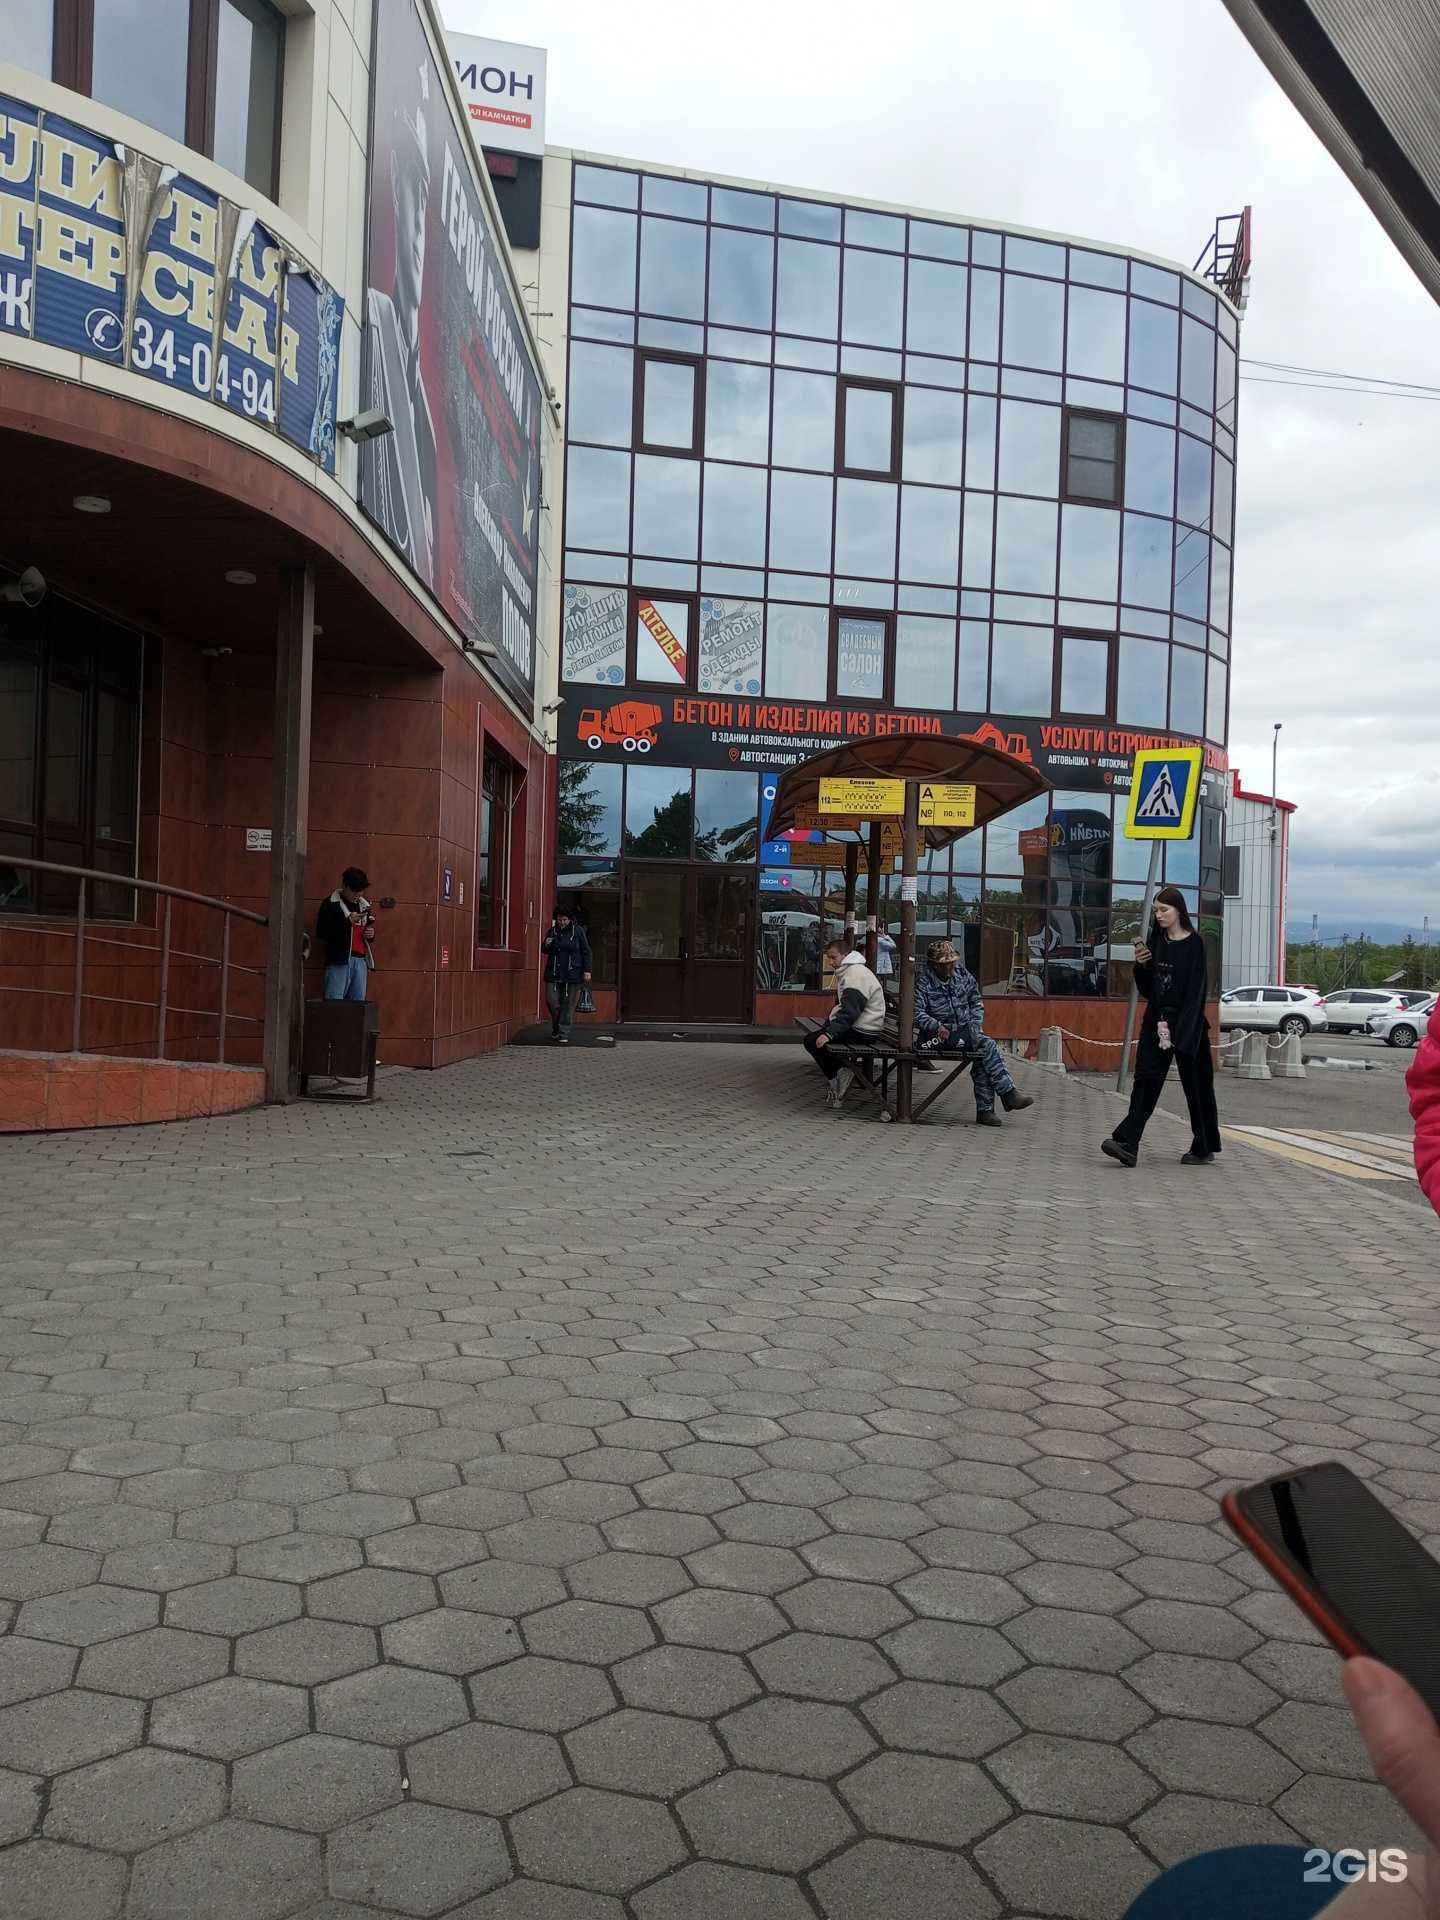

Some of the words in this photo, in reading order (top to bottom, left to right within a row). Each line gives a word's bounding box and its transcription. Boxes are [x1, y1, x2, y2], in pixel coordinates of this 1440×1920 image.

[482, 109, 528, 126] КАМЧАТКИ
[441, 140, 486, 316] ГЕРОЙ
[484, 266, 524, 426] РОССИИ
[131, 317, 277, 422] 34-04-94
[565, 590, 626, 632] ПОДШИВ
[502, 584, 531, 681] ПОПОВ
[565, 615, 625, 656] ПОДГОНКА
[639, 606, 685, 663] АТЕЛЬЕ
[701, 611, 762, 653] РЕМОНТ
[841, 632, 882, 651] СВАДЕБНЫЙ
[700, 637, 761, 677] ОДЕЖДЫ
[673, 699, 732, 725] БЕТОН
[738, 703, 750, 728] И
[755, 705, 841, 734] ИЗДЕЛИЯ
[846, 711, 870, 736] ИЗ
[875, 713, 942, 737] БЕТОНА
[712, 731, 717, 742] В
[718, 732, 749, 745] ЗДАНИИ
[750, 734, 820, 749] АВТОВОКЗАЛЬНОГО
[740, 750, 797, 764] АВТОСТАНЦИЯ
[1040, 726, 1104, 752] УСЛУГИ
[1048, 755, 1089, 766] АВТОВЫШКА
[1097, 757, 1129, 769] АВТОКРАН
[821, 796, 831, 804] 112
[920, 809, 933, 818] №
